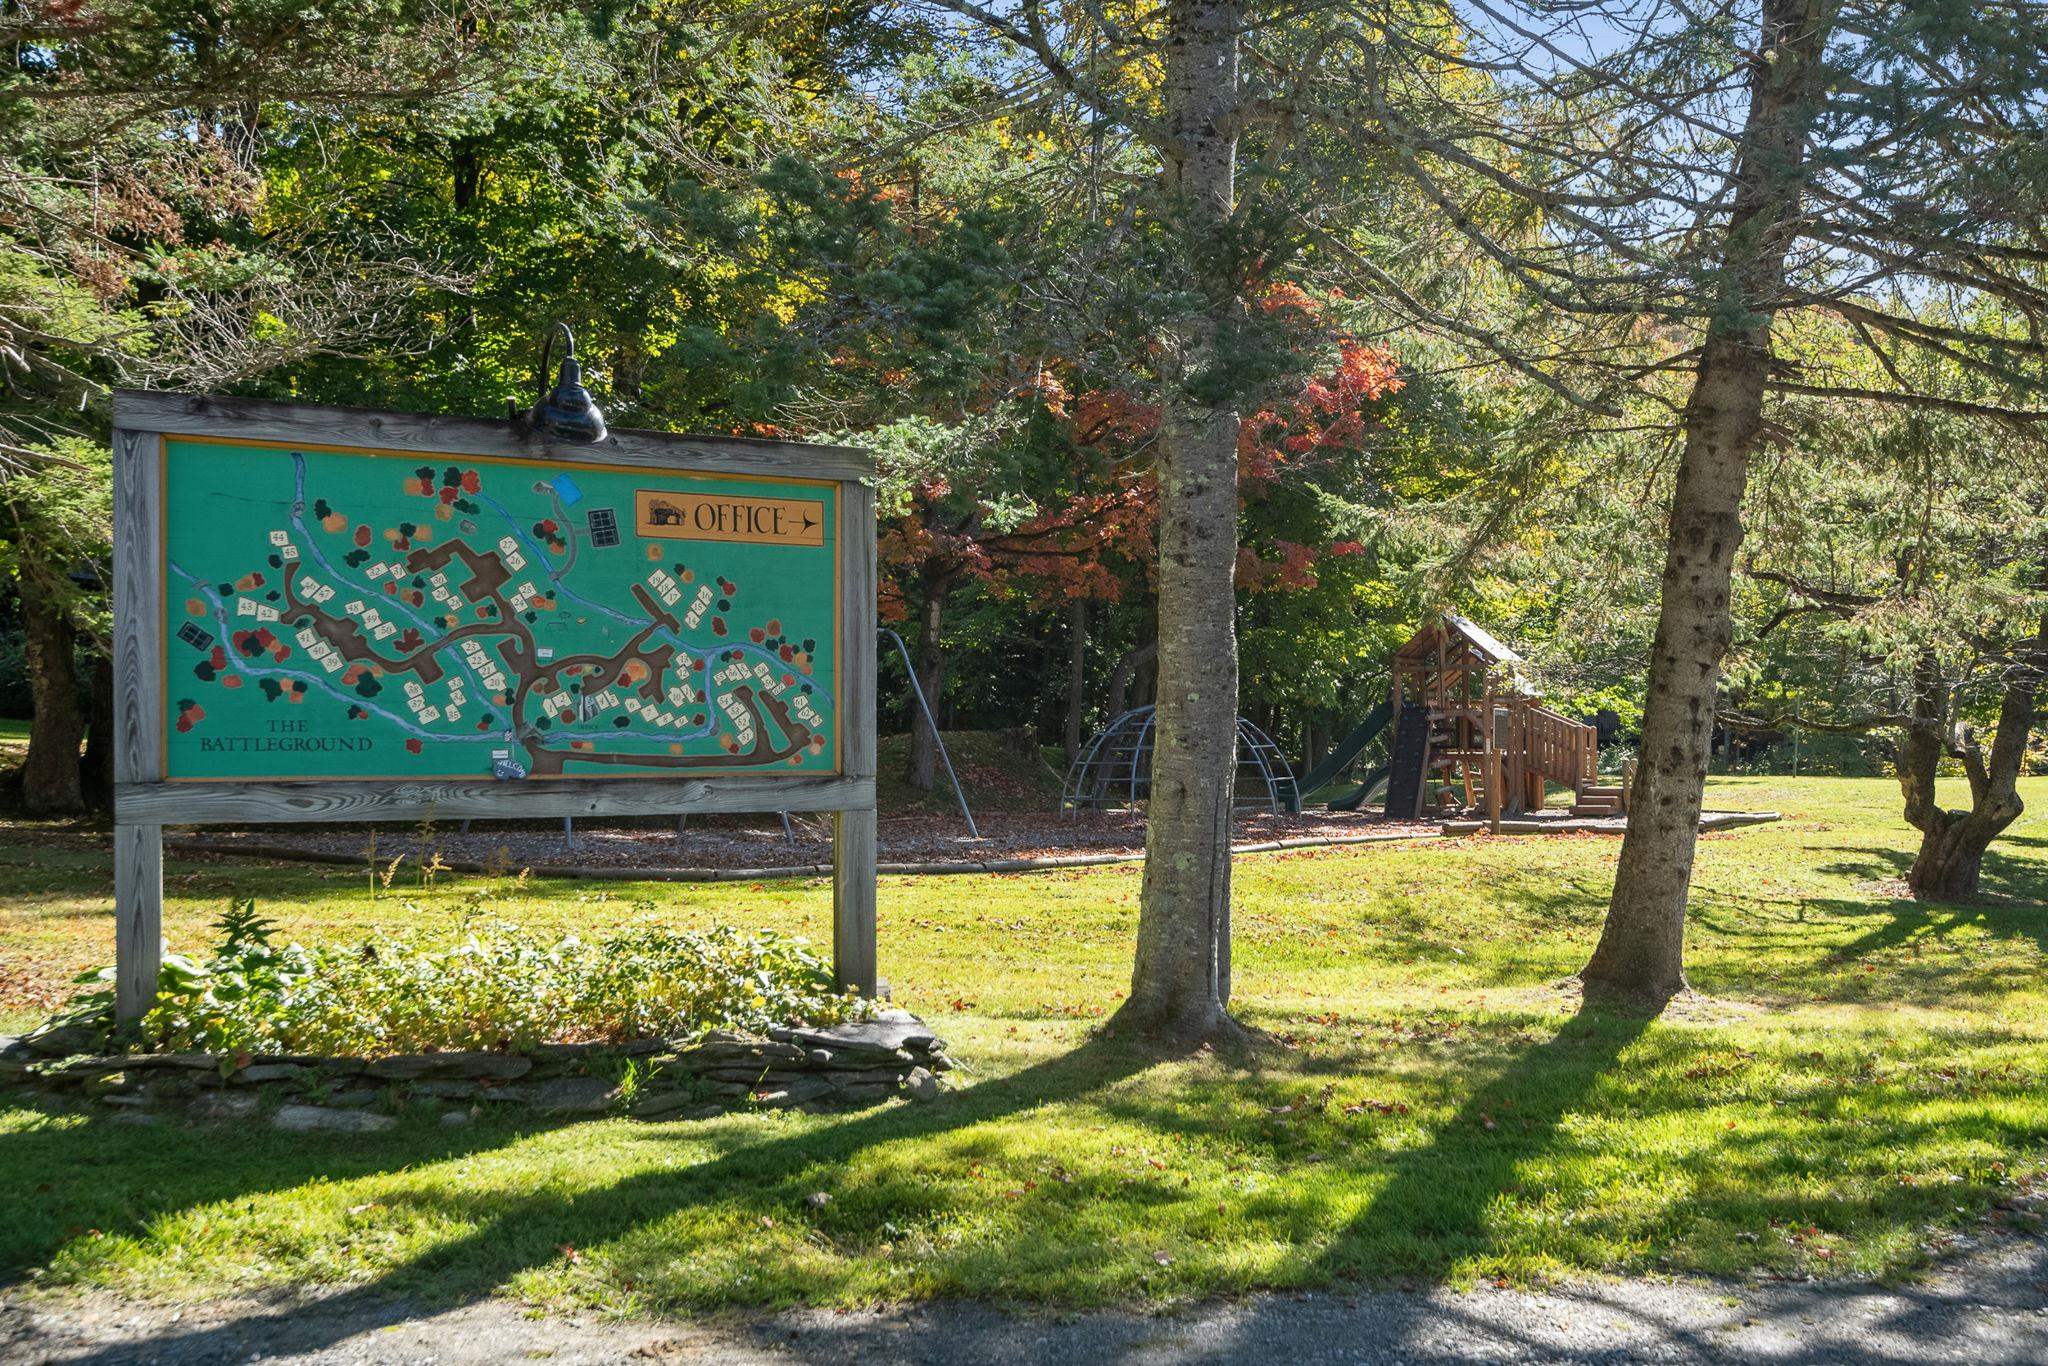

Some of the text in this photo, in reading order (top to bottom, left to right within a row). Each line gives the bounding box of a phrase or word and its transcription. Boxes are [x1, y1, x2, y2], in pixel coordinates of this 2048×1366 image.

[694, 502, 788, 536] OFFICE
[273, 532, 284, 541] 44
[503, 540, 513, 549] 27
[285, 548, 296, 556] 45
[510, 555, 521, 564] 26
[370, 568, 380, 576] 32
[653, 576, 661, 584] 19
[305, 582, 316, 590] 46
[523, 585, 532, 594] 25
[320, 589, 331, 597] 47
[436, 589, 446, 598] 29
[670, 593, 678, 601] 17
[702, 591, 710, 599] 16
[241, 602, 252, 610] 43
[695, 603, 703, 611] 15
[261, 609, 272, 618] 42
[366, 614, 378, 623] 49
[688, 617, 696, 625] 14
[300, 633, 310, 641] 41
[313, 646, 324, 654] 40
[327, 658, 338, 666] 39
[471, 656, 482, 664] 22
[482, 667, 491, 675] 21
[490, 679, 500, 687] 20
[765, 679, 773, 687] 59
[409, 685, 419, 693] 38
[454, 693, 464, 701] 34
[673, 693, 681, 701] 10
[720, 697, 729, 705] 54
[411, 699, 422, 708] 37
[425, 709, 435, 718] 36
[731, 706, 739, 714] 53
[801, 709, 810, 717] 62
[267, 720, 309, 732] THE
[738, 718, 747, 726] 52
[742, 733, 749, 741] 51
[201, 737, 373, 751] BATTLEGROUND
